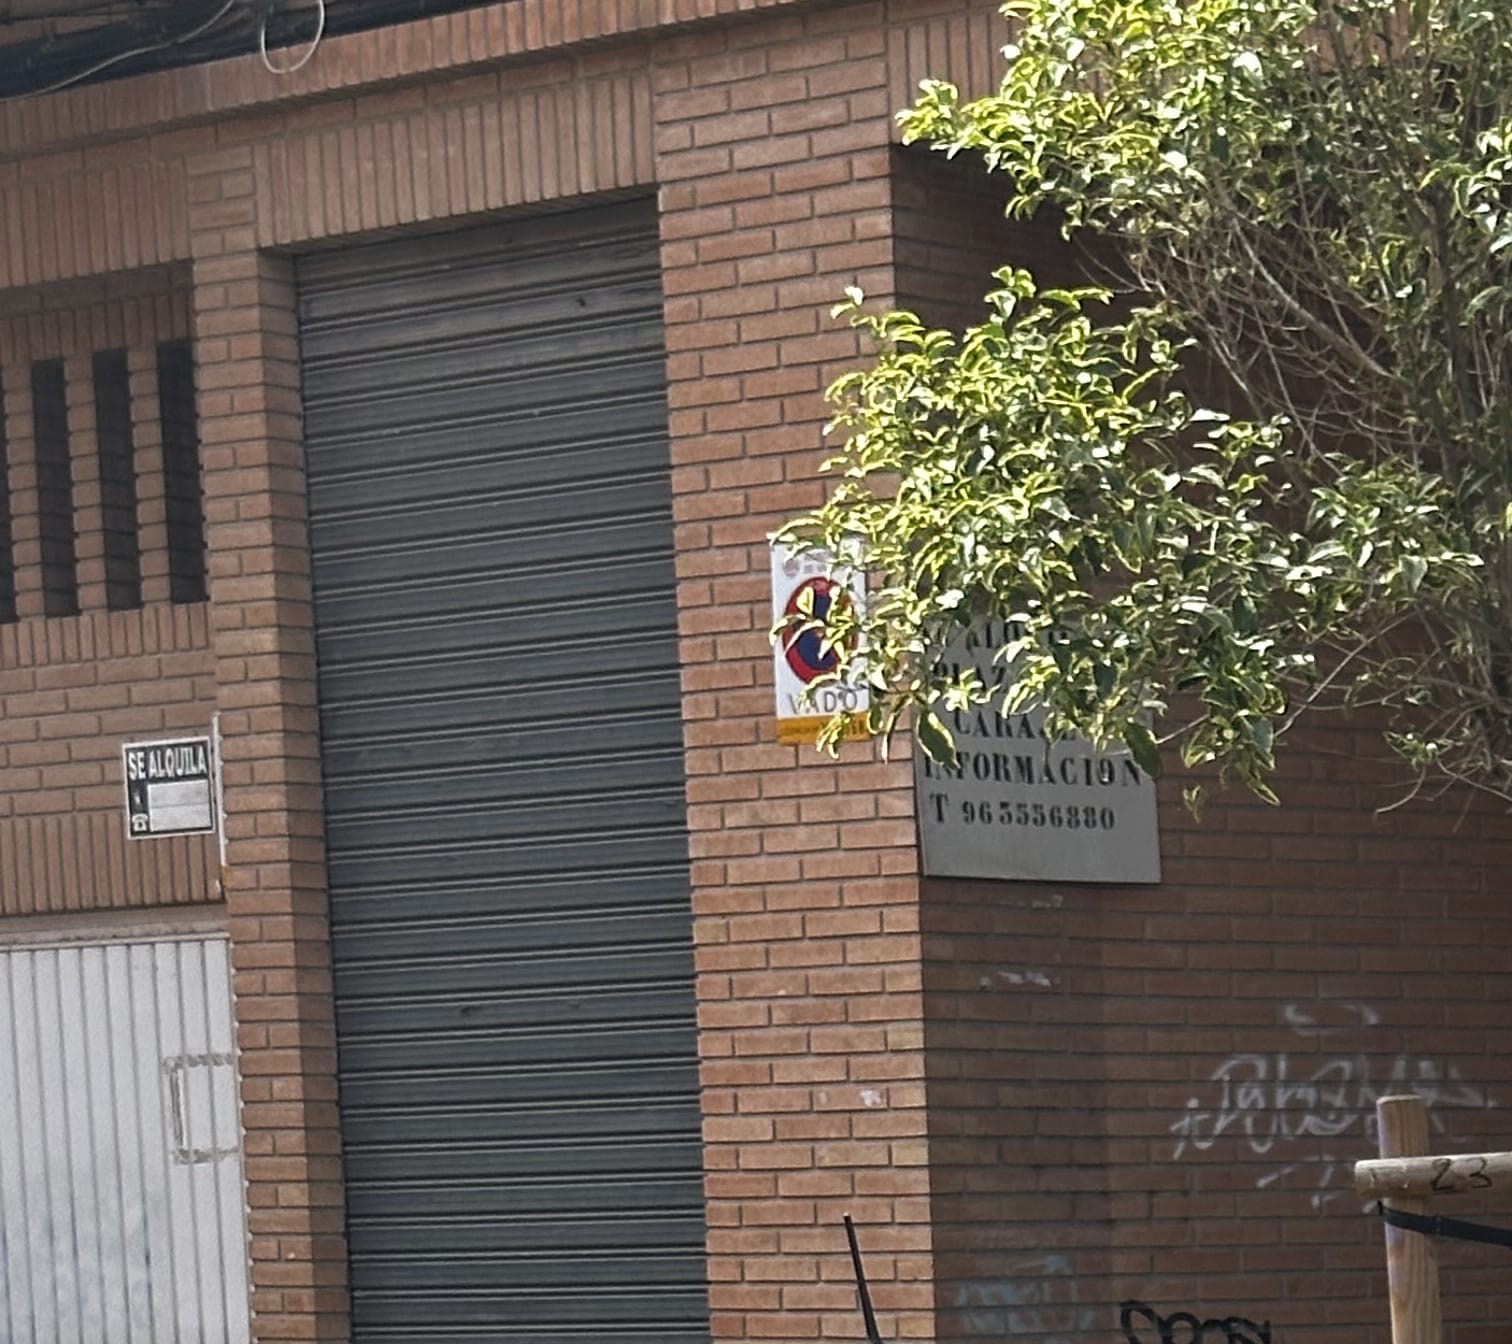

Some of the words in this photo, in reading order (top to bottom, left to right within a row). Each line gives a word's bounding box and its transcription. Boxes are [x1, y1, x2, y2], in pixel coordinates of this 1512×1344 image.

[128, 751, 147, 780] SE
[148, 744, 207, 778] ALQUILA
[929, 793, 949, 823] T
